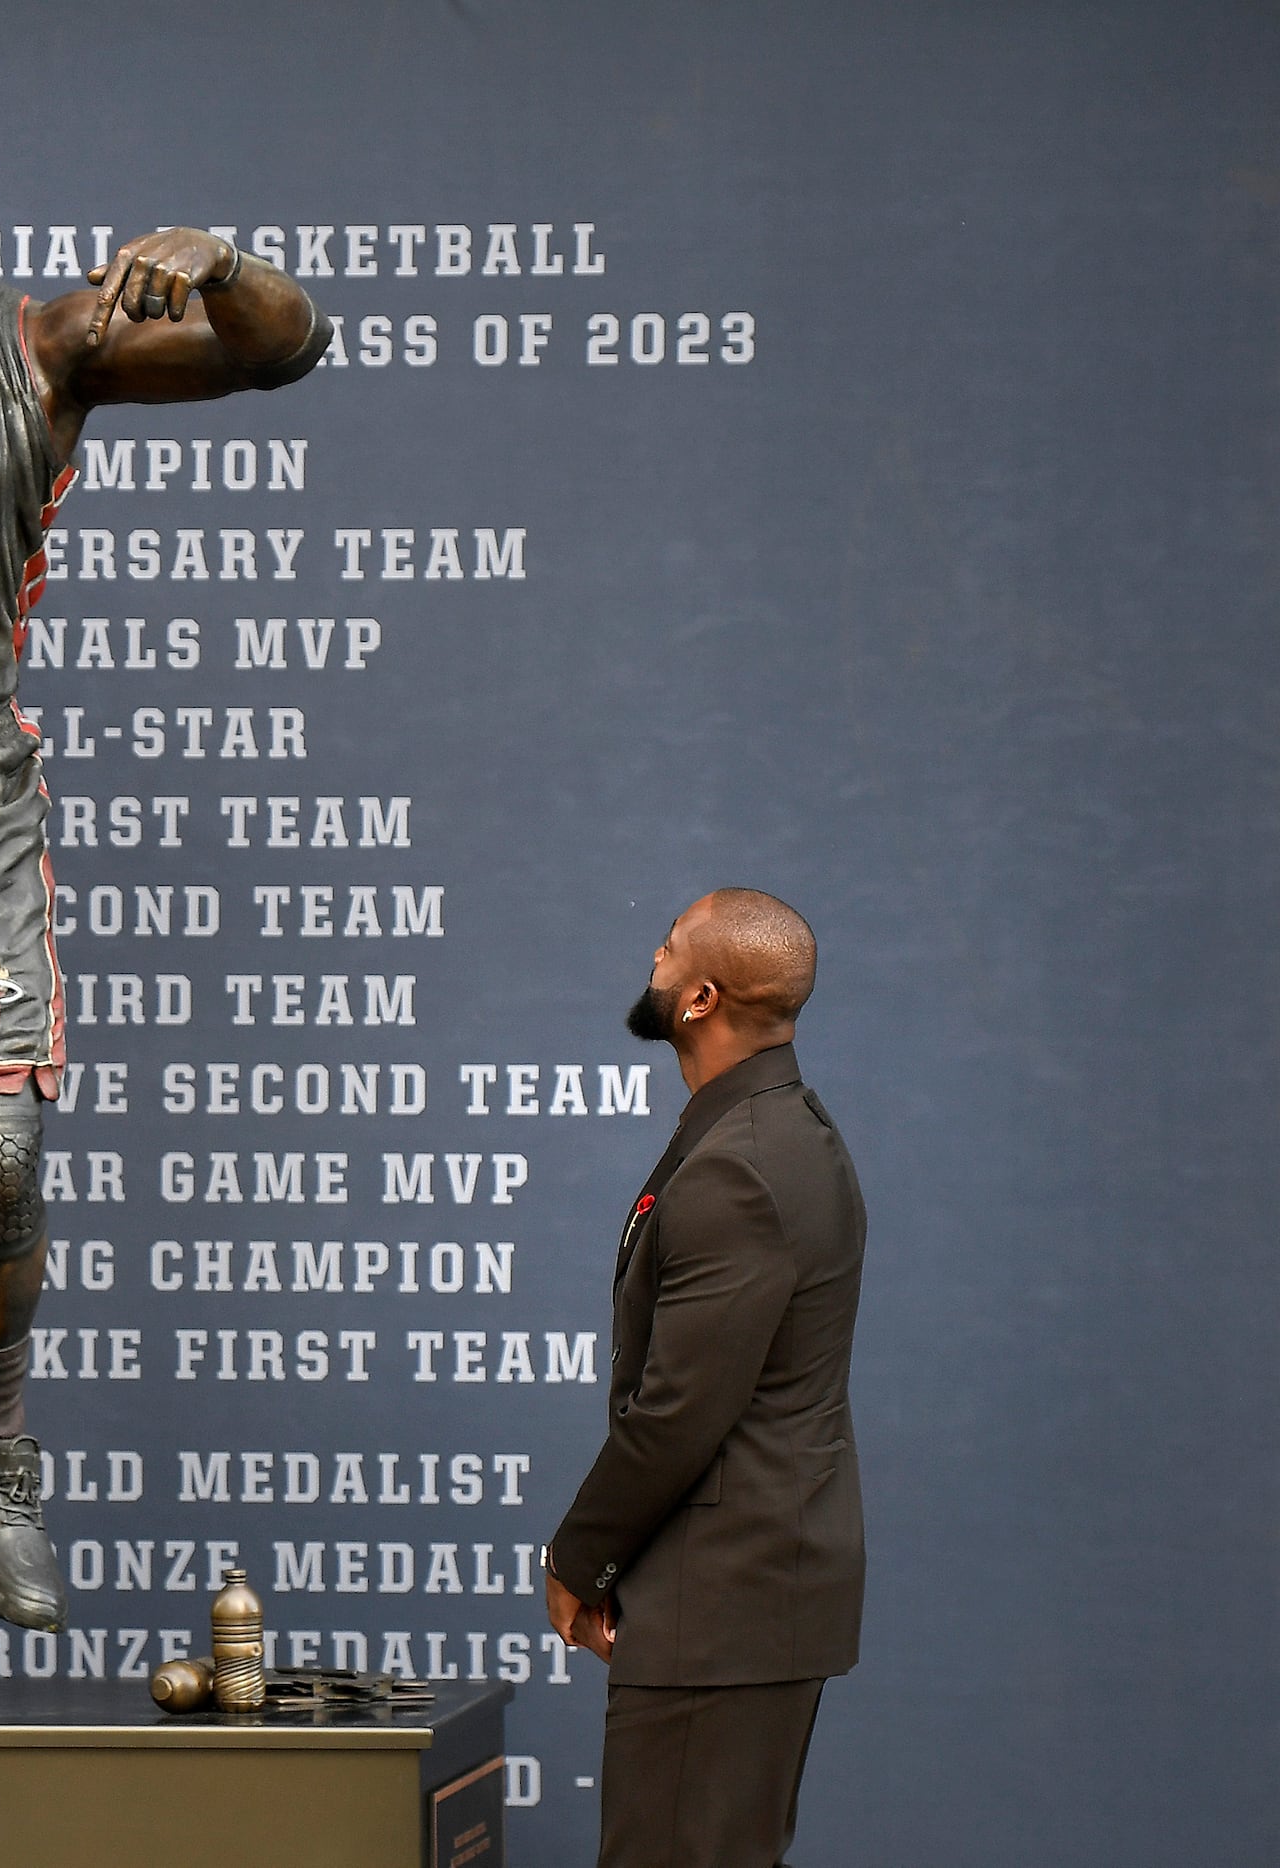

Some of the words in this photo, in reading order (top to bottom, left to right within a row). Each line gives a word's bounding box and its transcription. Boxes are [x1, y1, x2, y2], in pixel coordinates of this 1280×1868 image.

[156, 223, 606, 278] SKETBALL
[320, 316, 438, 368] ASS
[474, 314, 553, 367] OF
[587, 312, 755, 366] 2023
[83, 440, 309, 492] MPION
[42, 529, 305, 581] ERSARY
[334, 528, 527, 581] TEAM
[27, 618, 201, 670] NALS
[234, 619, 382, 670] MVP
[41, 797, 190, 848] RST
[221, 797, 412, 849] TEAM
[53, 886, 220, 937] COND
[254, 886, 445, 938] TEAM
[65, 974, 192, 1025] IRD
[226, 975, 417, 1026] TEAM
[163, 1063, 426, 1115] SECOND
[459, 1064, 651, 1117] TEAM
[161, 1152, 348, 1203] GAME
[382, 1153, 528, 1205] MVP
[151, 1241, 515, 1294] CHAMPION
[176, 1330, 377, 1381] FIRST
[407, 1331, 598, 1384] TEAM
[179, 1452, 530, 1505] MEDALIST
[51, 1541, 240, 1591] ONZE
[274, 1542, 535, 1595] MEDALI
